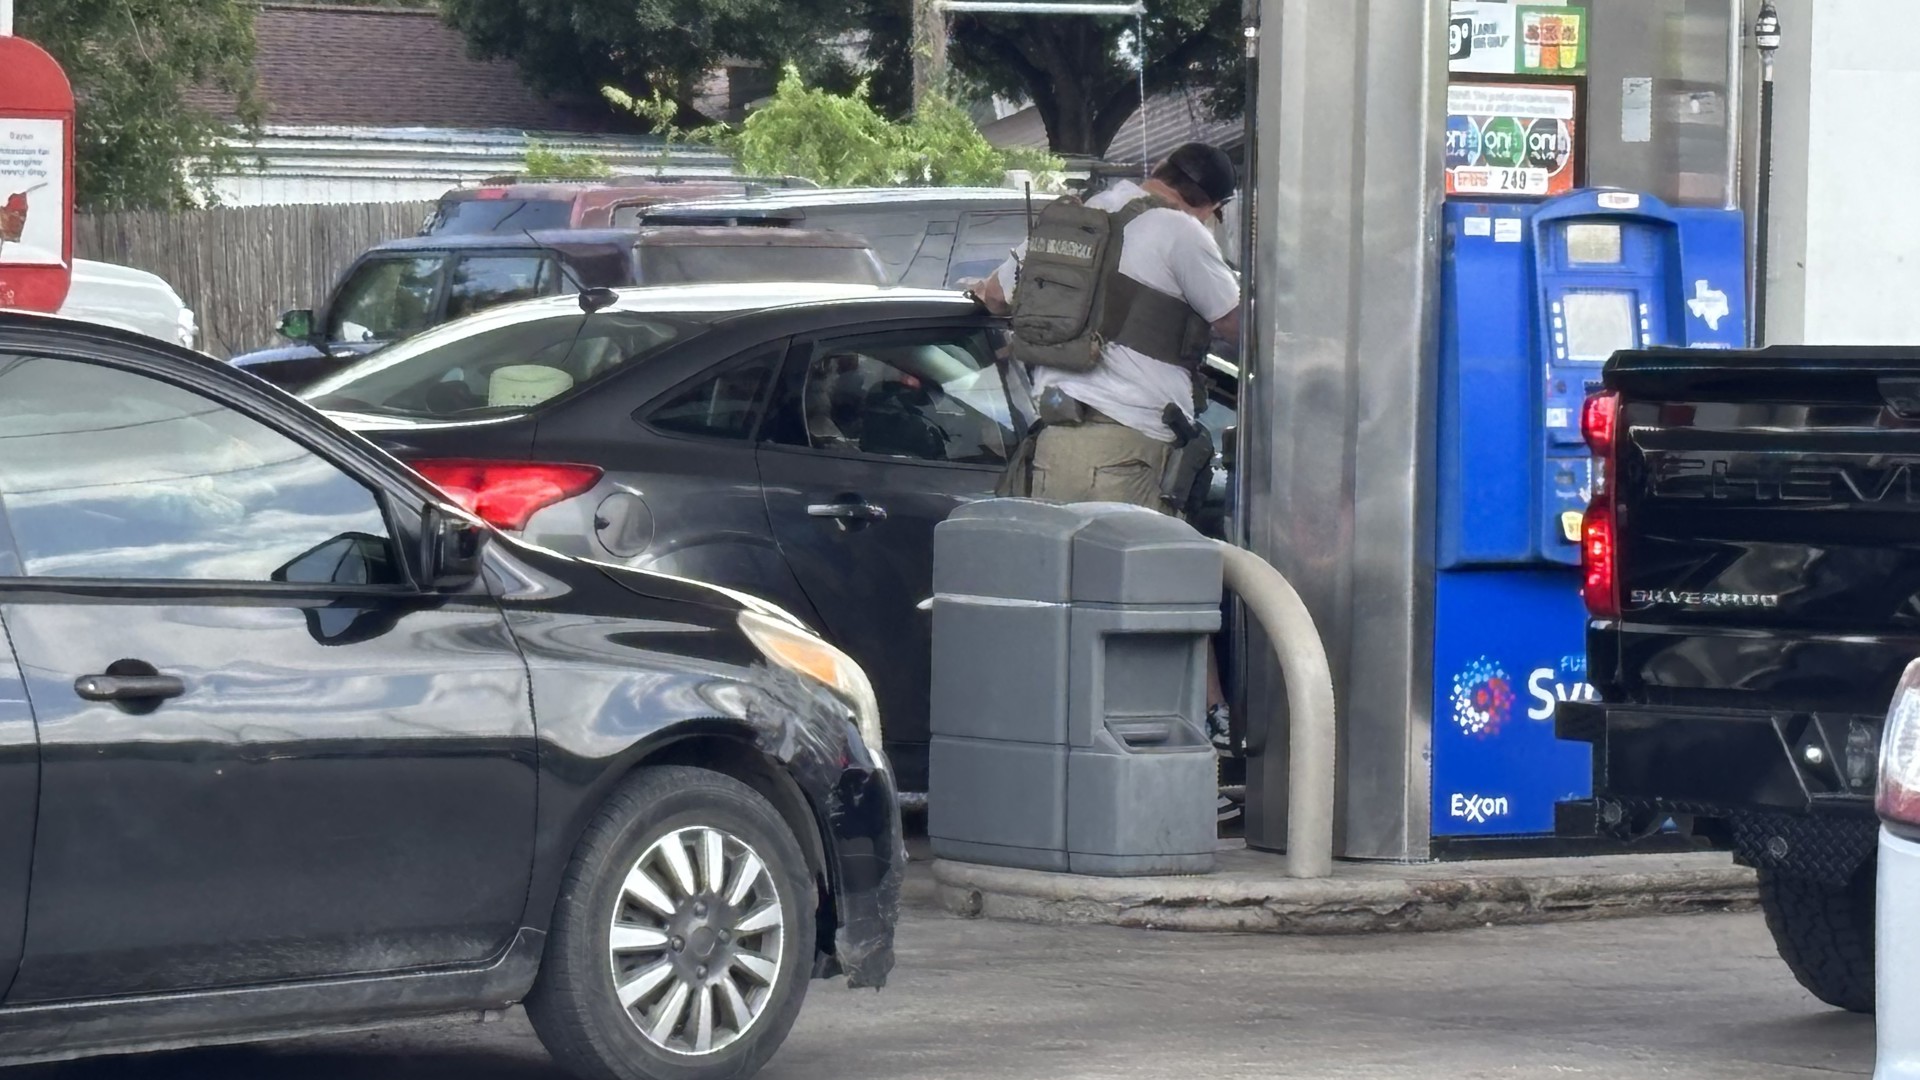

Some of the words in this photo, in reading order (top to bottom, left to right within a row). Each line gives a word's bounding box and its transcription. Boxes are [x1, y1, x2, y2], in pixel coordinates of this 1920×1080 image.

[1650, 456, 1920, 503] CHEV
[1629, 588, 1779, 607] SILVERADO
[1450, 792, 1509, 824] Exxon
